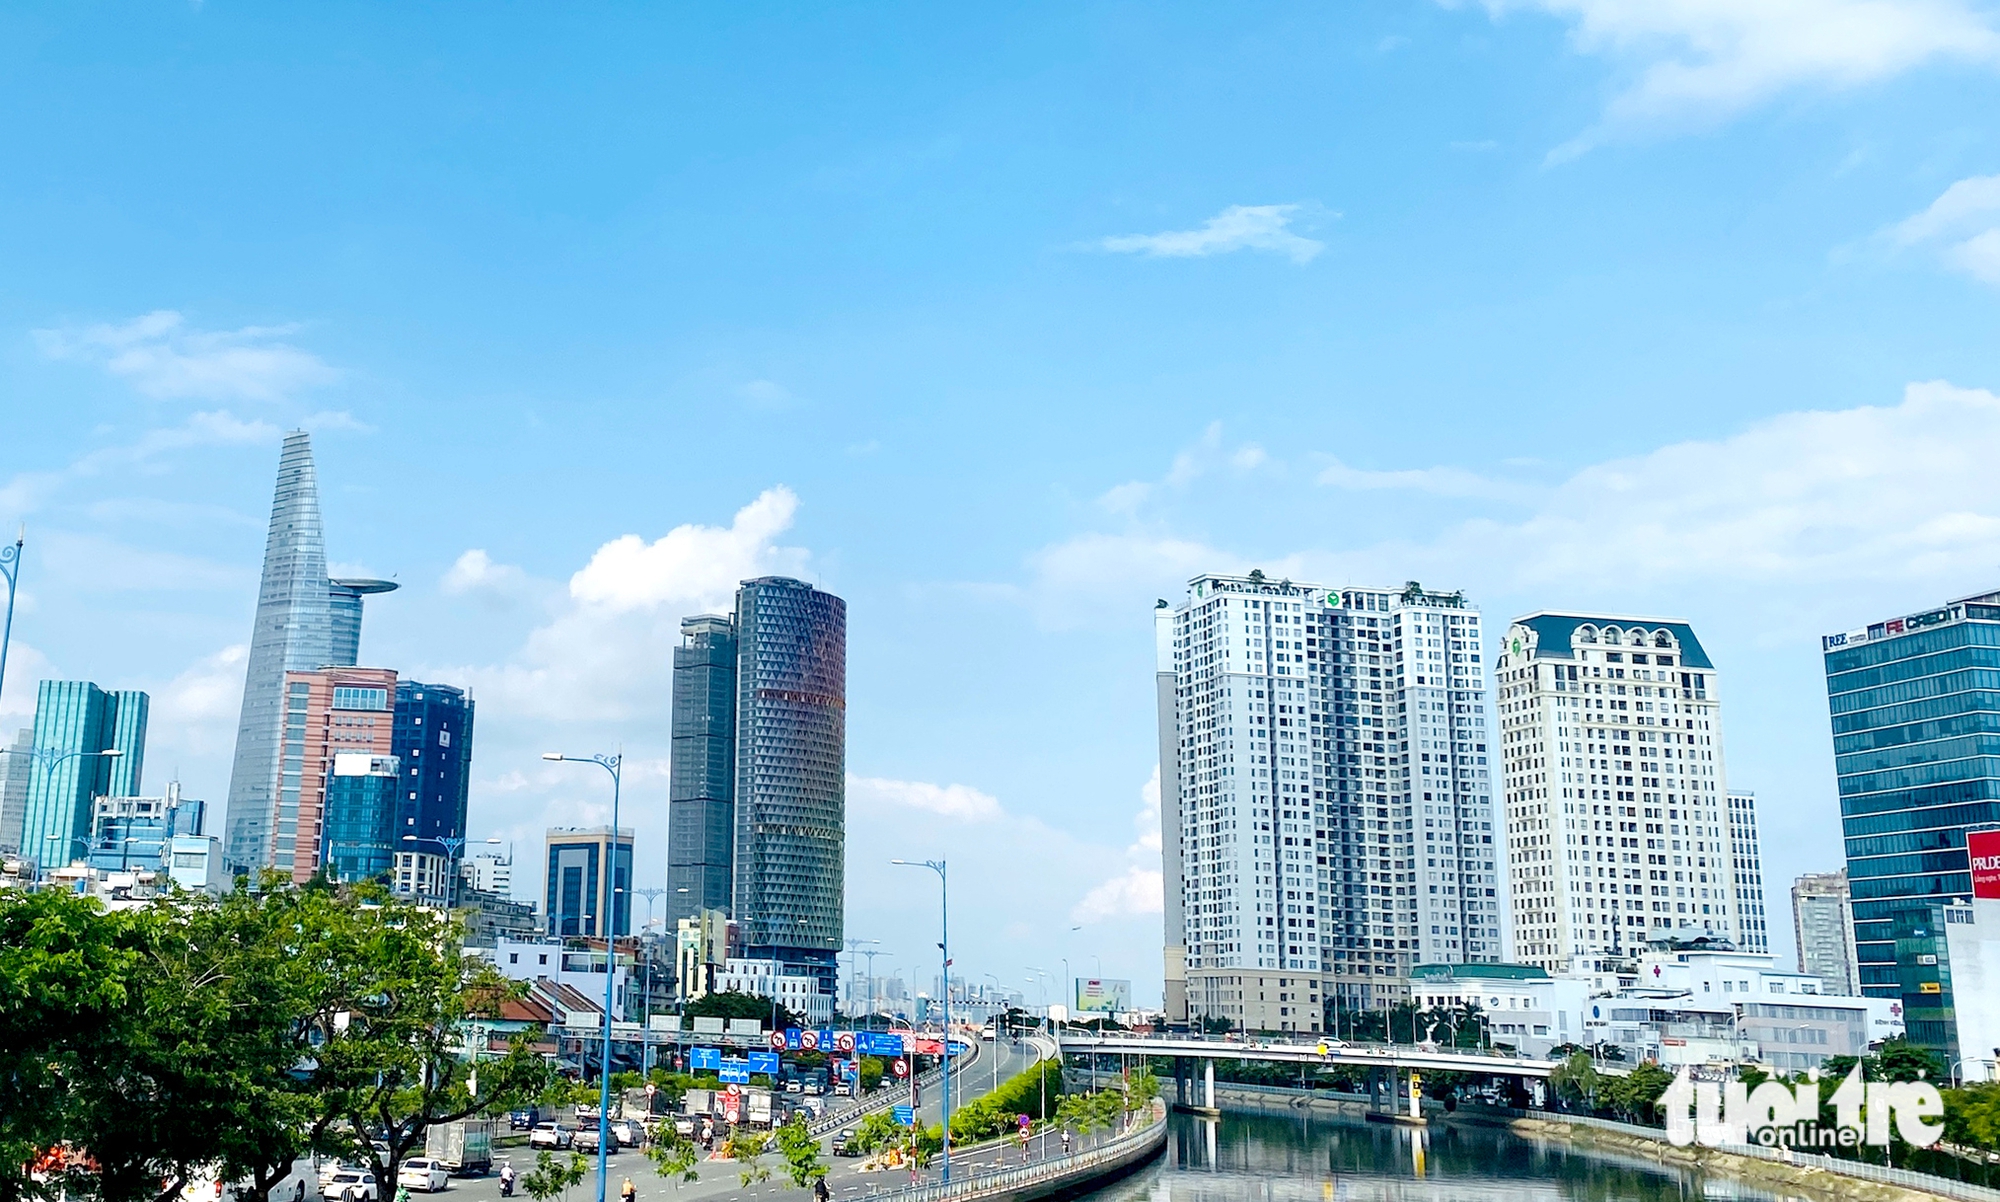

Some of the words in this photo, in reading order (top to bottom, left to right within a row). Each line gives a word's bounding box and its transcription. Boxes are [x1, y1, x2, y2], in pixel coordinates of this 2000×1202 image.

[1886, 619, 1904, 634] FE
[1906, 606, 1961, 629] CREDIT
[1829, 633, 1848, 647] REE
